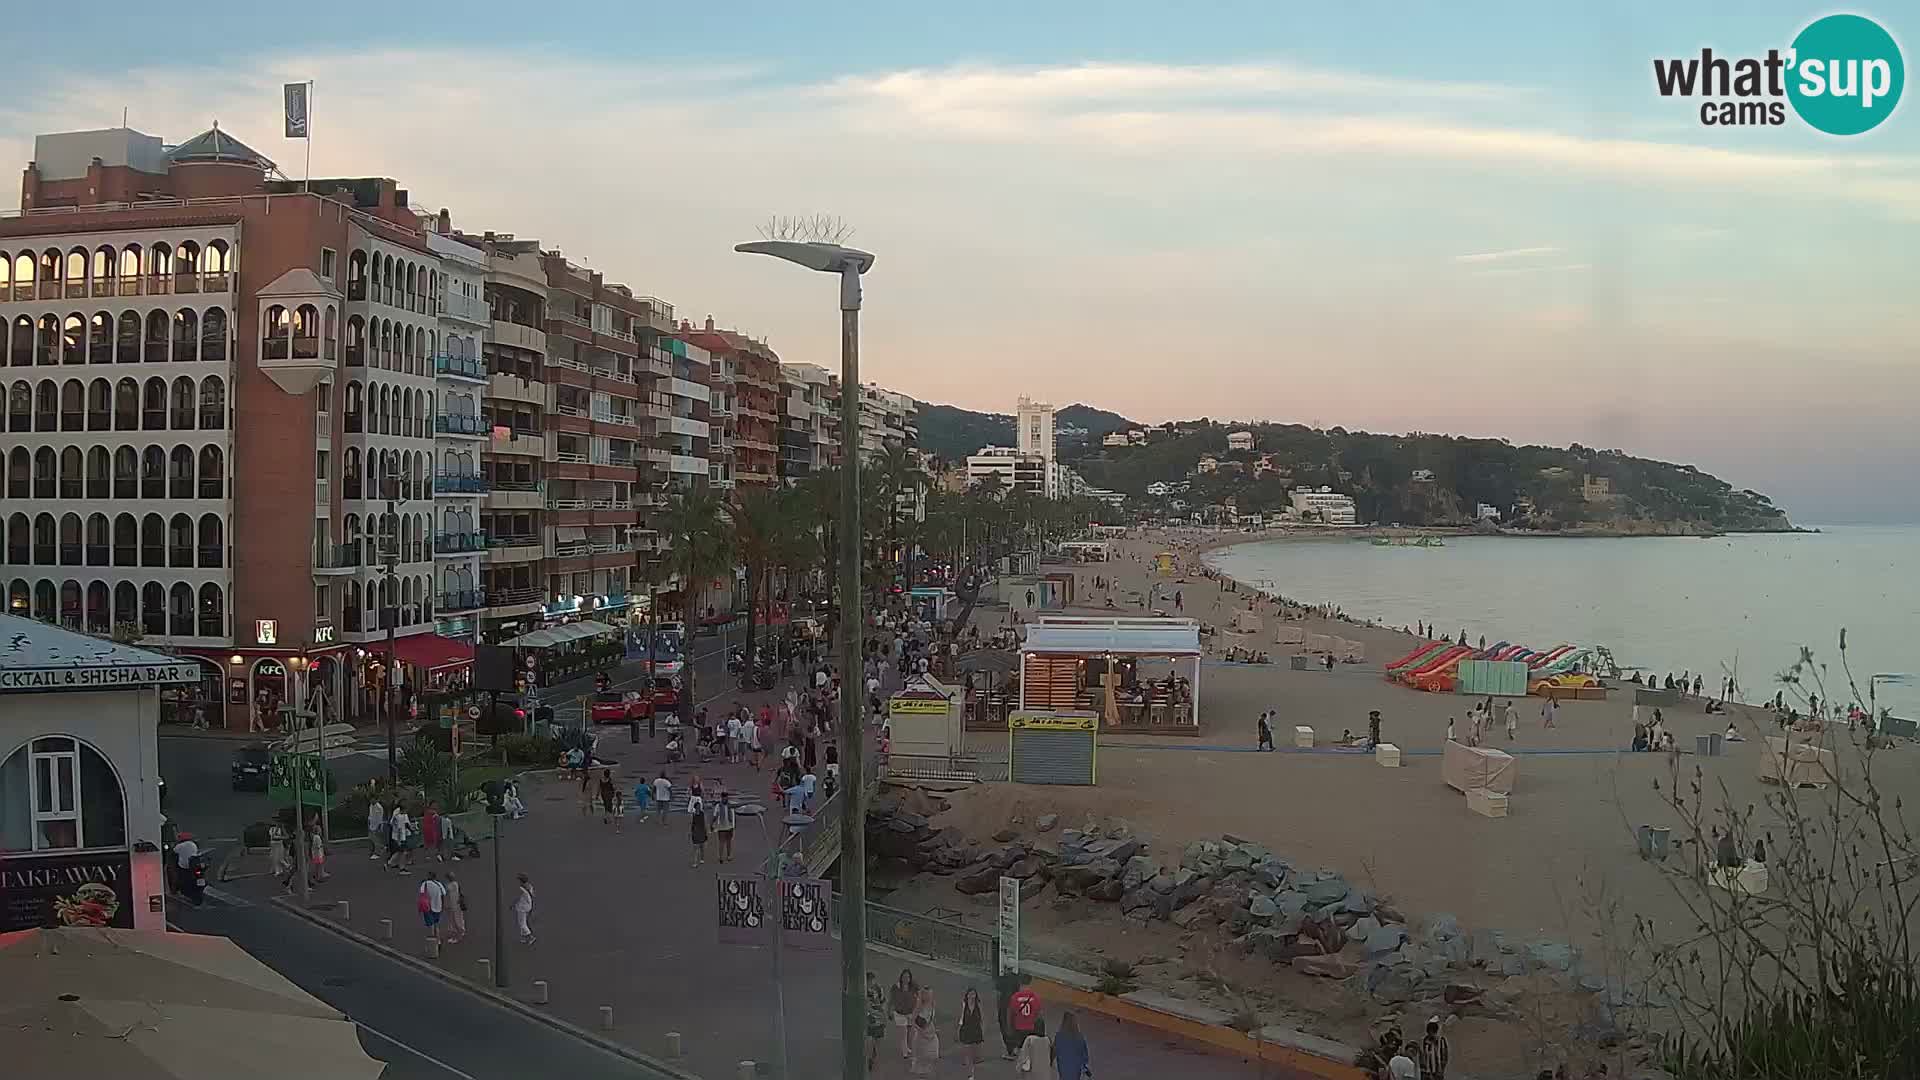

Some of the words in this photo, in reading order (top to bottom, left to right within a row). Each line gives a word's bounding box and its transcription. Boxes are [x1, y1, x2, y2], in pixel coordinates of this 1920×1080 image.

[315, 626, 334, 643] KFC
[65, 670, 76, 684] &
[81, 667, 142, 684] SHISHA
[146, 667, 179, 682] BAR
[260, 665, 283, 675] KFC
